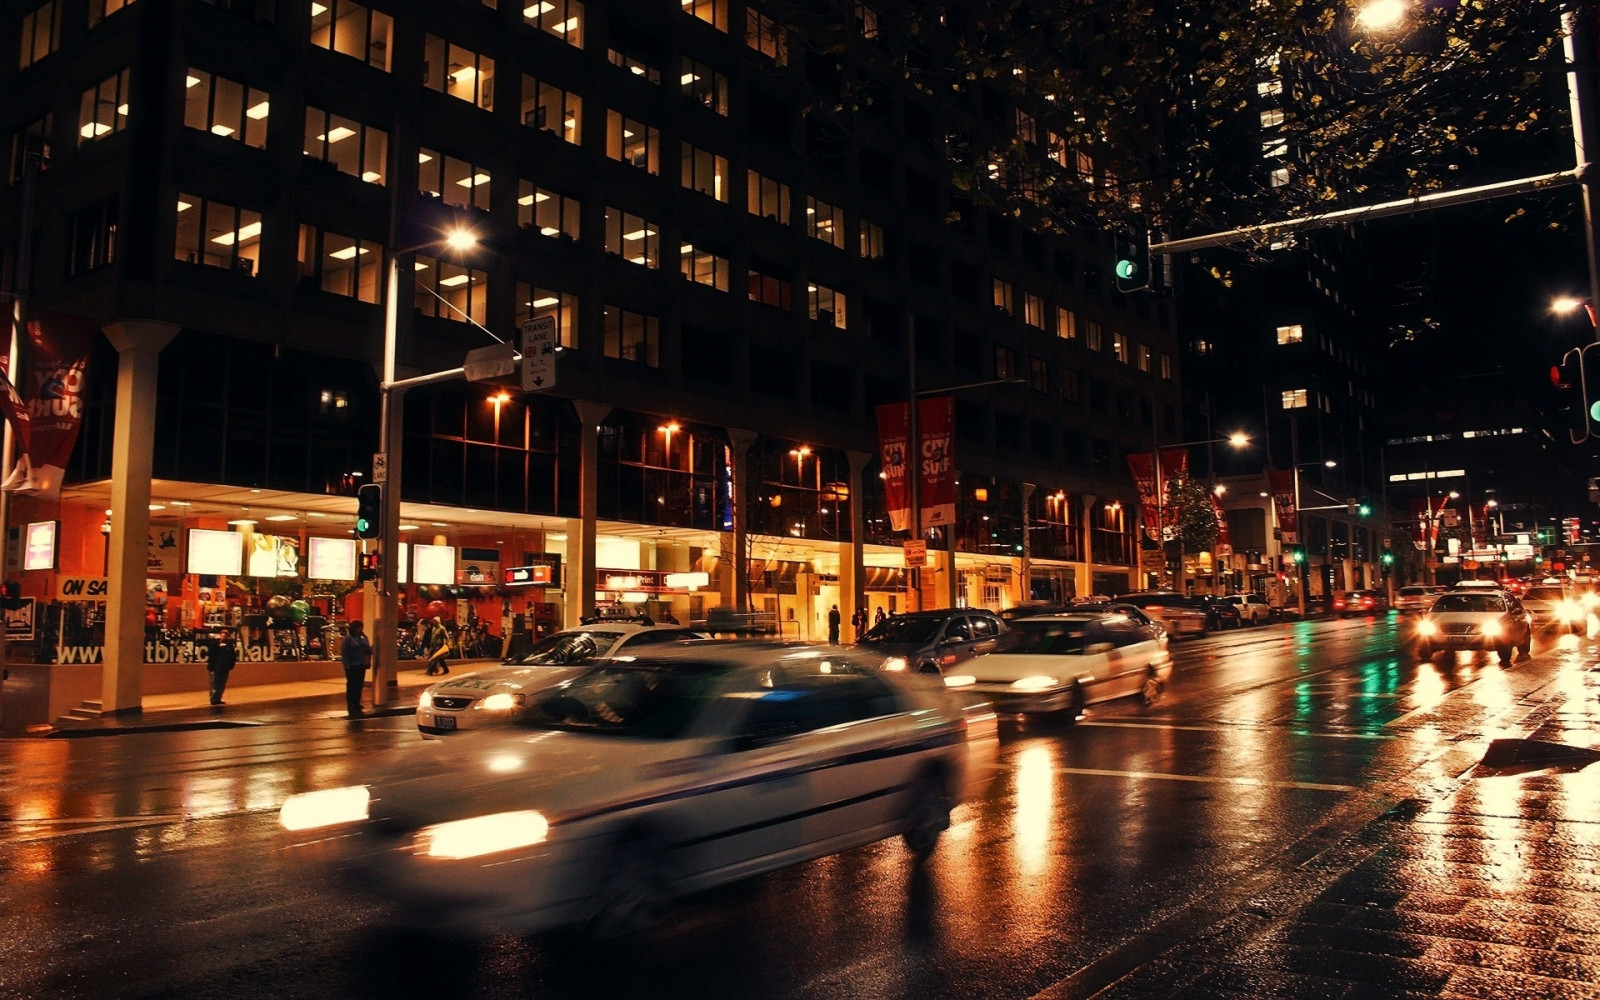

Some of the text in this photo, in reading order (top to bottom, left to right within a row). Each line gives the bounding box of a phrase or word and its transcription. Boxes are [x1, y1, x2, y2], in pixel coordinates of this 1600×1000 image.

[524, 320, 552, 333] TRANSIT
[528, 332, 548, 343] LANE
[922, 437, 950, 458] CITY
[922, 457, 950, 476] SURF
[637, 575, 654, 585] Print
[63, 580, 107, 595] ON SA
[608, 608, 626, 616] TAXI
